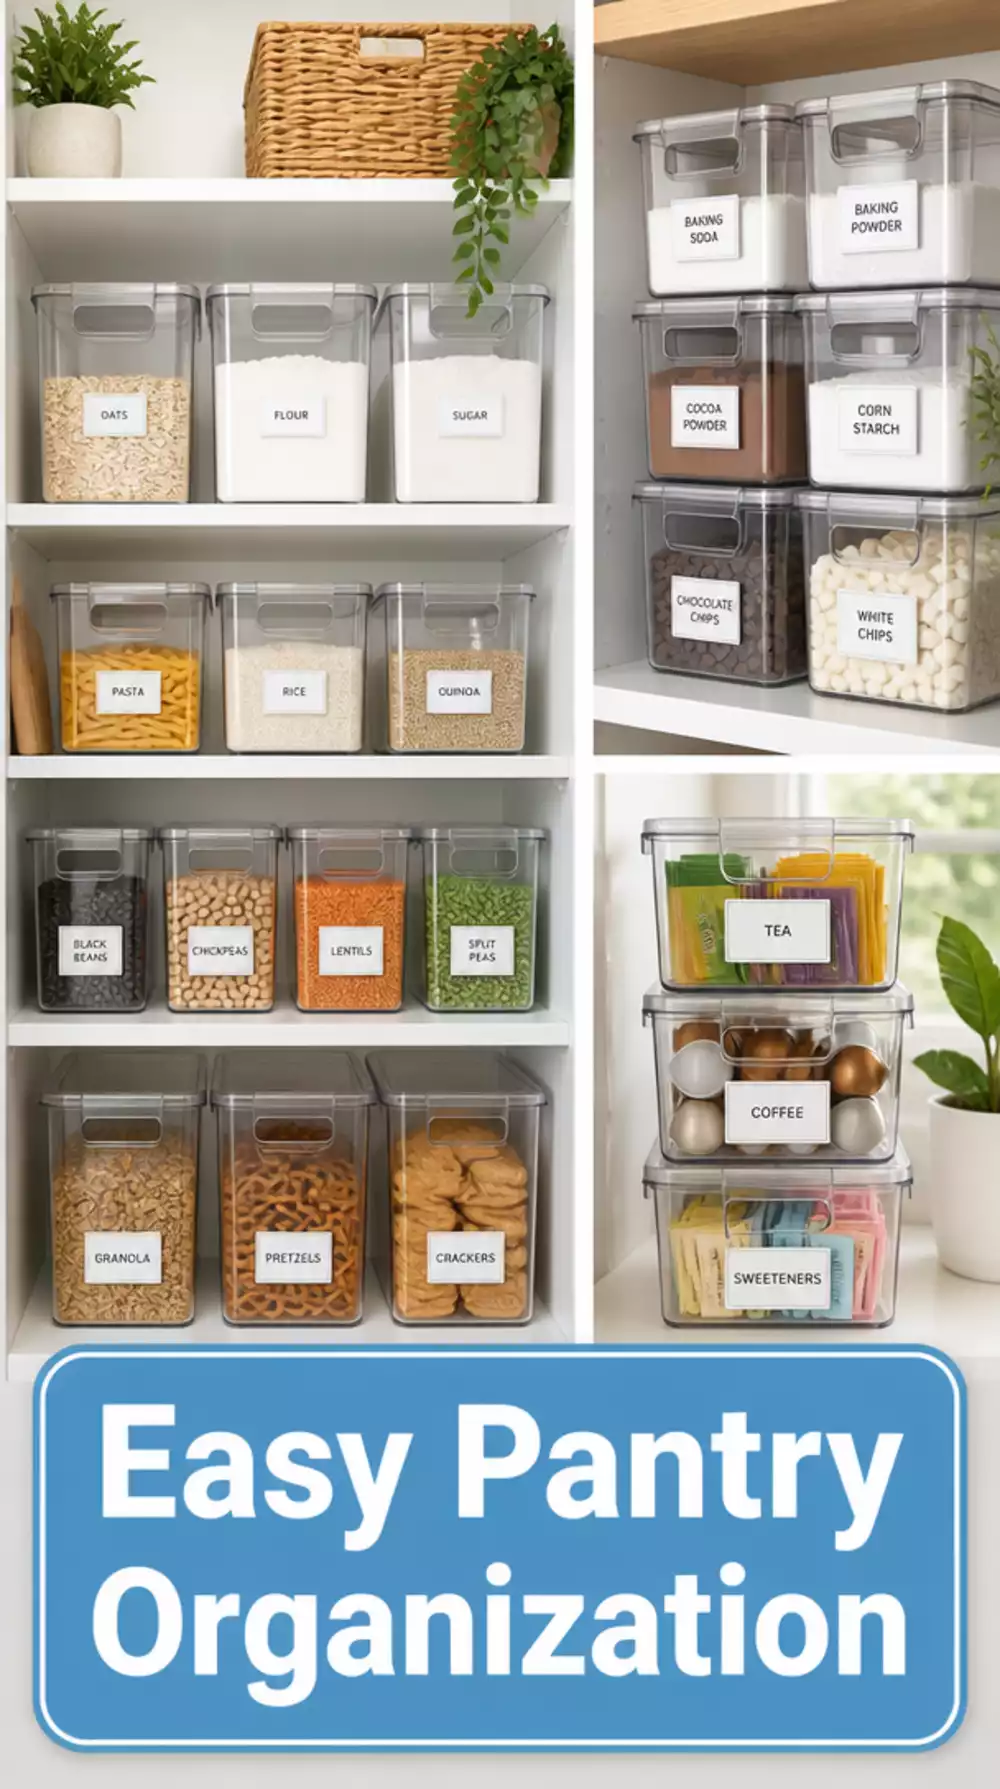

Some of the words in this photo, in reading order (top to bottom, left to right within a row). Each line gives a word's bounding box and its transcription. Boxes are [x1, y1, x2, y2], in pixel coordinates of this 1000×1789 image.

[855, 201, 898, 216] BAKING
[685, 213, 723, 227] BAKING
[852, 219, 902, 233] POWDER
[690, 231, 718, 243] SODA
[686, 403, 722, 414] COCOA
[858, 404, 892, 417] CORN
[101, 411, 128, 419] OATS
[275, 411, 308, 420] FLOUR
[453, 411, 487, 420] SUGAR
[683, 419, 727, 431] POWDER
[853, 422, 900, 435] STARCH
[677, 594, 732, 611] CHOCOLATE
[857, 610, 894, 624] WHITE
[858, 627, 893, 642] CHIPS
[112, 687, 144, 696] PASTA
[283, 687, 305, 696] RICE
[764, 925, 792, 937] TEA
[74, 940, 106, 949] BLACK
[469, 939, 495, 949] SPLIT
[331, 946, 372, 956] LENTILS
[74, 952, 107, 962] BEANS
[469, 952, 496, 962] PEAS
[751, 1106, 803, 1118] COFFEE
[95, 1253, 150, 1263] GRANOLA
[266, 1253, 321, 1263] PRETZELS
[436, 1253, 495, 1263] CRACKERS
[734, 1273, 821, 1285] SWEETENERS
